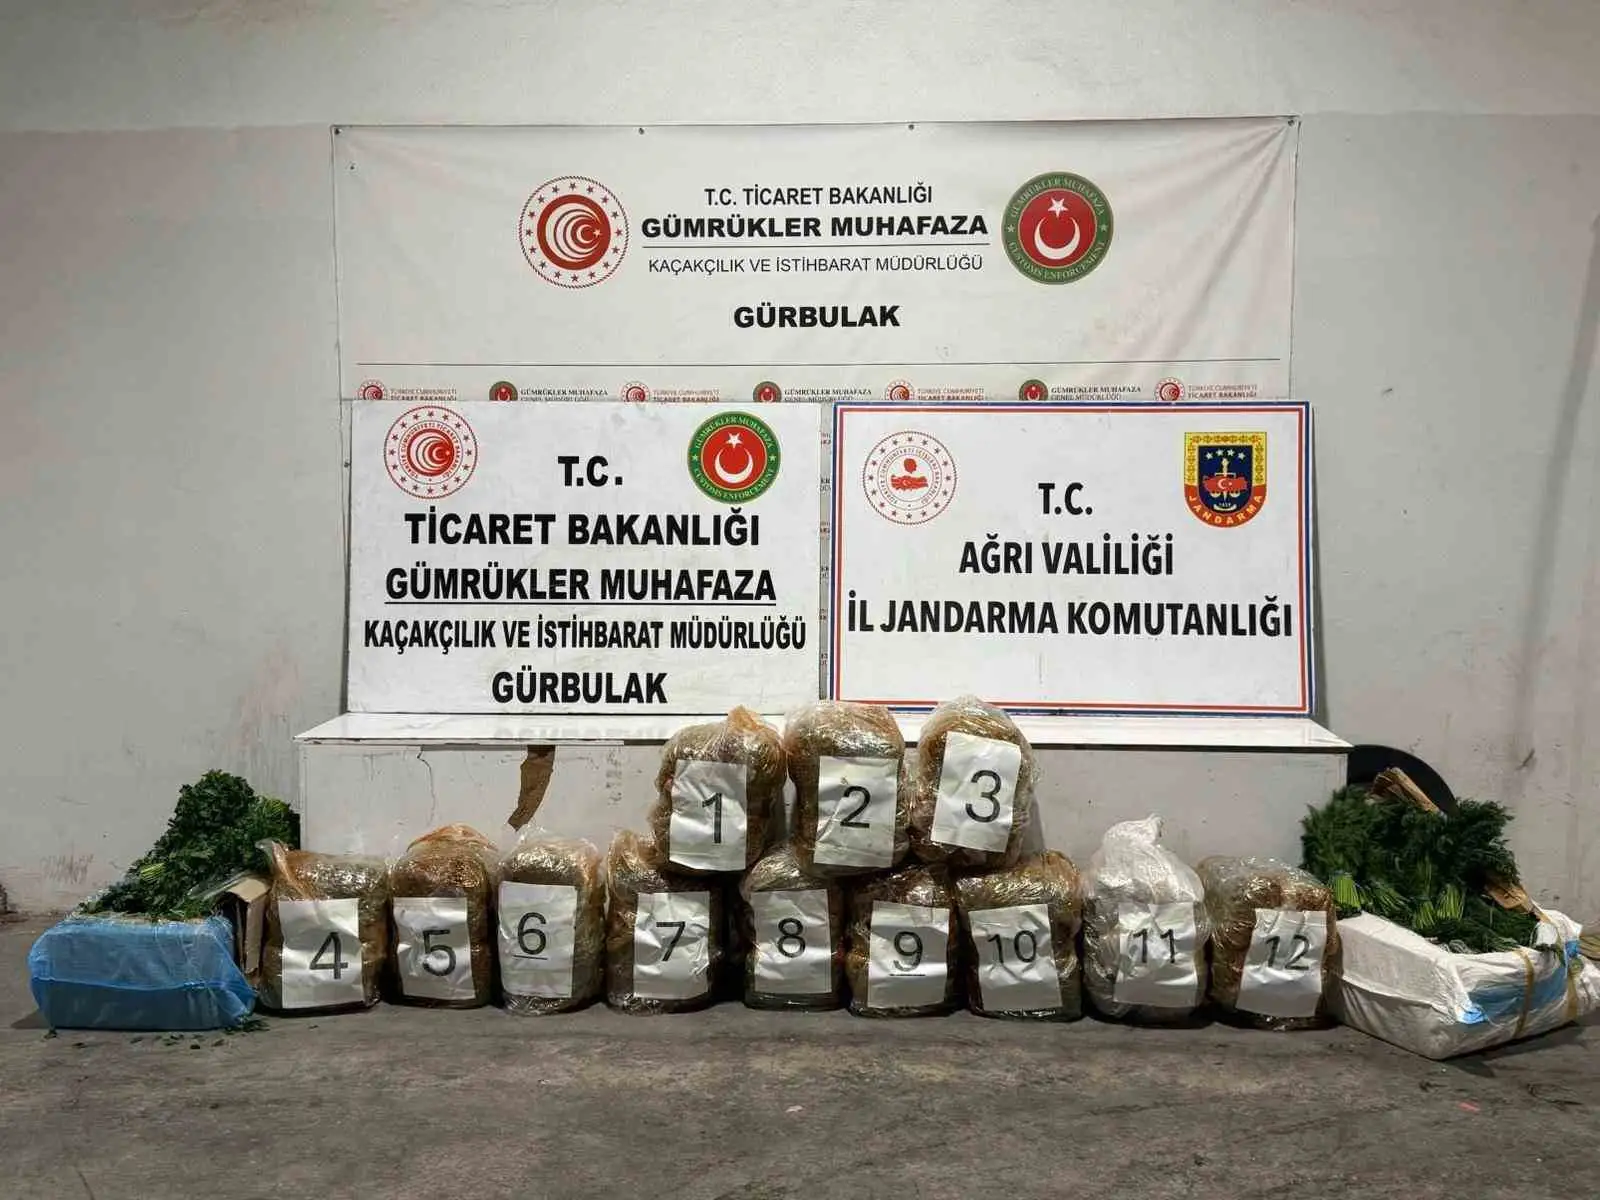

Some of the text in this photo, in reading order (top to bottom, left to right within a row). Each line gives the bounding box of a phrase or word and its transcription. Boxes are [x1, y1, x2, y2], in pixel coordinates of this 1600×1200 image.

[703, 181, 932, 206] T.C. TİCARET BAKANLIĞI
[641, 213, 989, 238] GÜMRÜKLER MUHAFAZA
[648, 254, 983, 277] KAÇAKÇILIK VE İSTİHBARAT MÜDÜRLÜĞÜ
[733, 301, 901, 329] GÜRBULAK
[557, 455, 623, 488] T.C.
[1038, 482, 1093, 516] T.C.
[1188, 495, 1263, 525] JANDARMA
[404, 505, 759, 546] TİCARET BAKANLIĞI
[958, 532, 1173, 576] AĞRI VALİLİĞİ
[385, 560, 777, 601] GÜMRÜKLER MUHAFAZA
[364, 613, 806, 655] KAÇAKÇILIK VE İSTİHBARAT MÜDÜRLÜĞÜ
[848, 589, 1292, 638] İL JANDARMA KOMUTANLIĞI
[491, 664, 668, 704] GÜRBULAK
[839, 785, 872, 830] 2
[965, 769, 1002, 823] 3
[701, 792, 723, 845] 1
[421, 928, 457, 977] 5
[517, 912, 547, 955] 6
[655, 921, 686, 962] 7
[777, 917, 807, 958] 8
[893, 931, 923, 972] 9
[987, 929, 1037, 966] 10
[1132, 927, 1178, 965] 11
[1264, 934, 1311, 971] 12
[309, 931, 348, 980] 4
